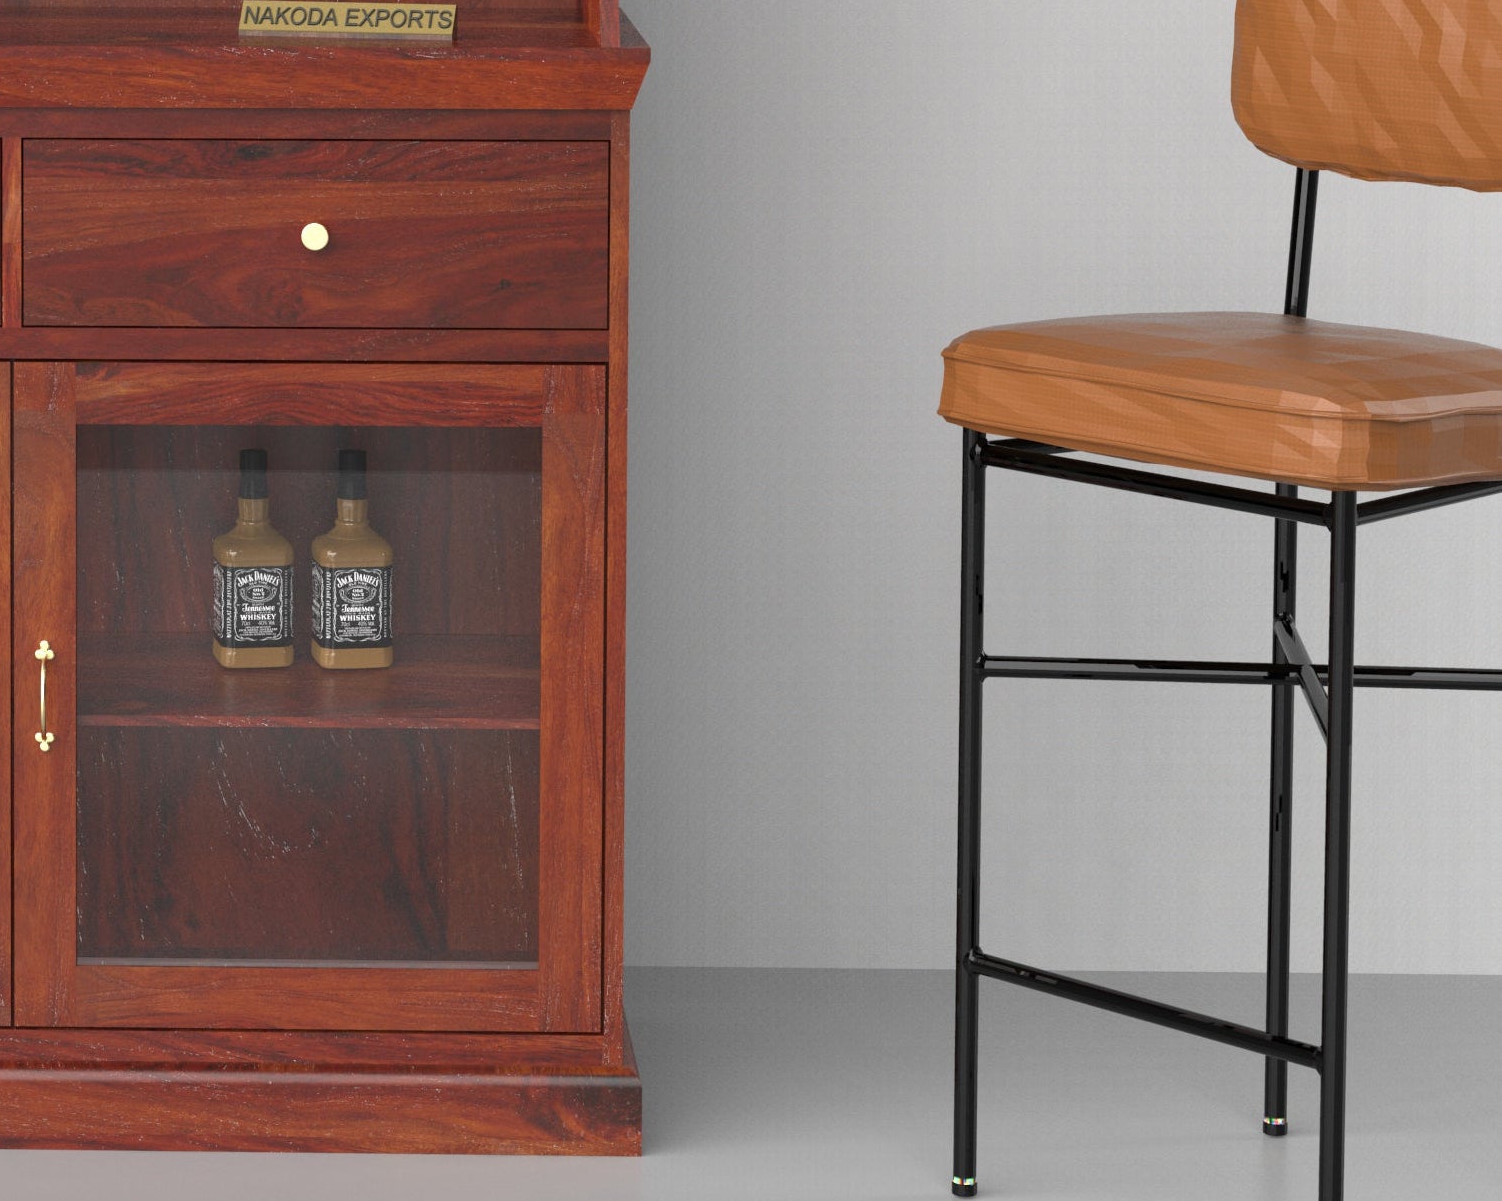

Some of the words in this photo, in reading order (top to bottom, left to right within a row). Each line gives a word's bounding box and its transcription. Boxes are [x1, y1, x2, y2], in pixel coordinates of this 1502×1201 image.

[244, 5, 338, 27] NAKODA
[345, 8, 453, 29] EXPORTS
[237, 574, 254, 587] JACK
[254, 571, 280, 586] DANIEL'S
[337, 575, 353, 588] JACK
[354, 571, 379, 587] DANIEL'S
[242, 603, 275, 612] Tennessee
[342, 604, 375, 613] Tennessee
